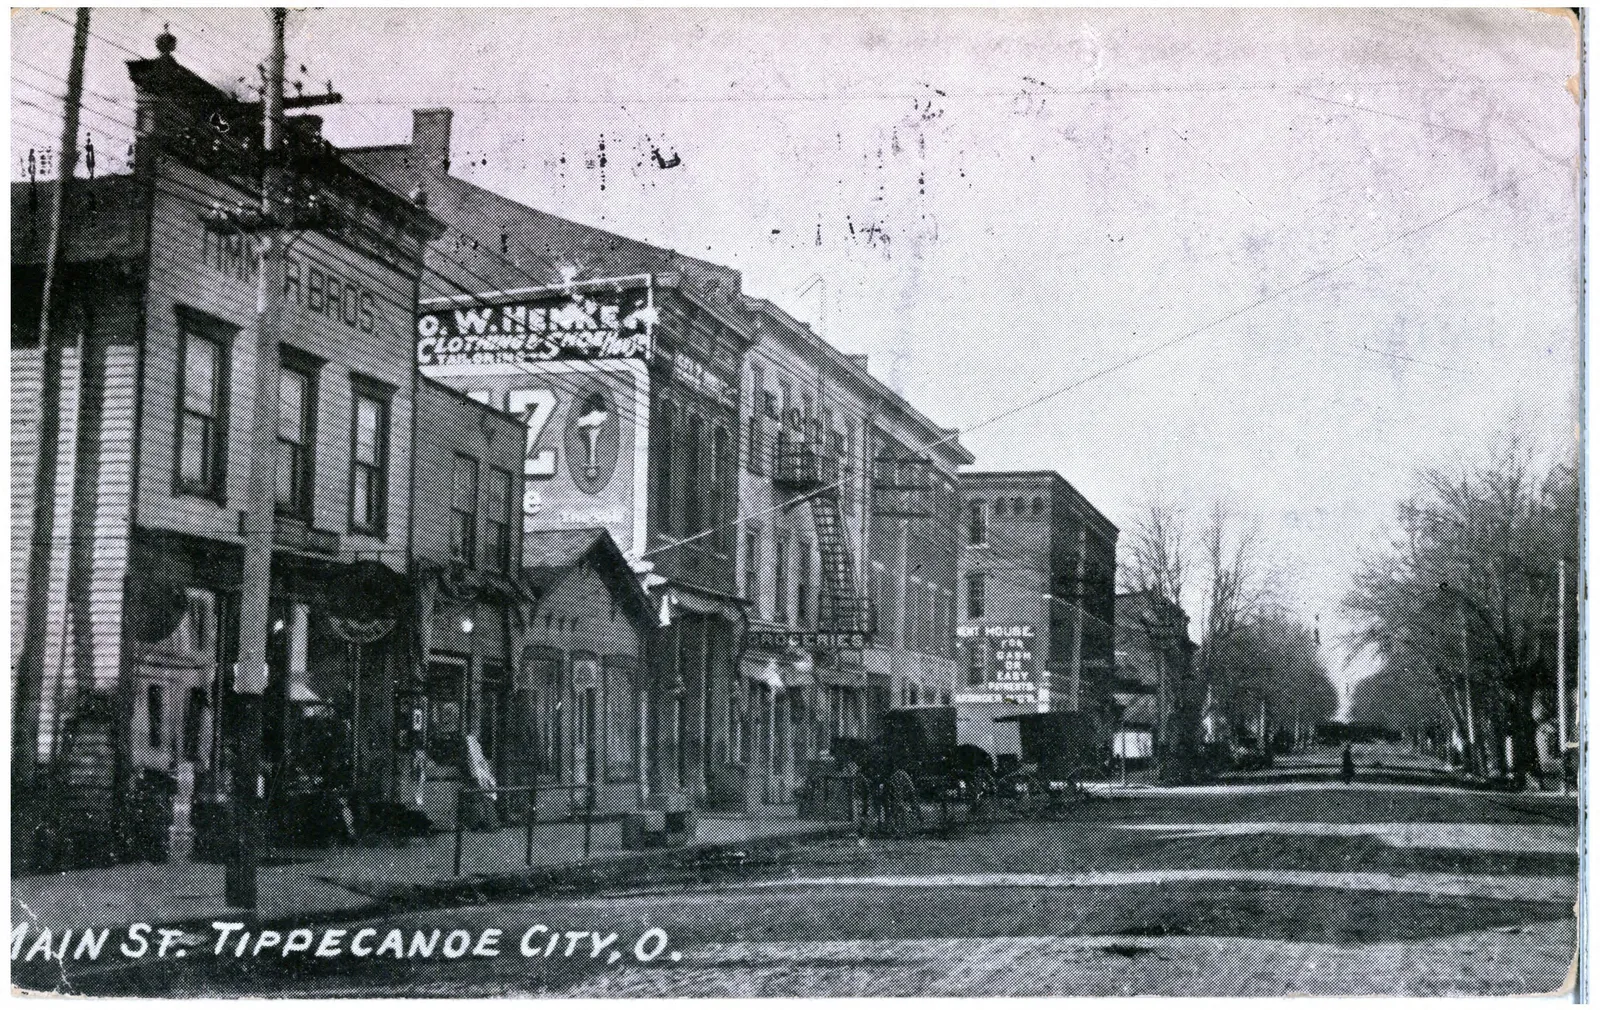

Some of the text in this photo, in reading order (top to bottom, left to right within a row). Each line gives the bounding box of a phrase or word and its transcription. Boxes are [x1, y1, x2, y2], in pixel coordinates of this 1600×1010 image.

[308, 266, 380, 337] BROS.
[454, 307, 497, 334] W.
[418, 331, 527, 363] CLOTHING
[747, 631, 865, 648] GROCERIES
[1000, 638, 1025, 650] FOR
[996, 650, 1032, 661] CASH
[1004, 660, 1022, 671] OR
[996, 671, 1029, 682] EASY
